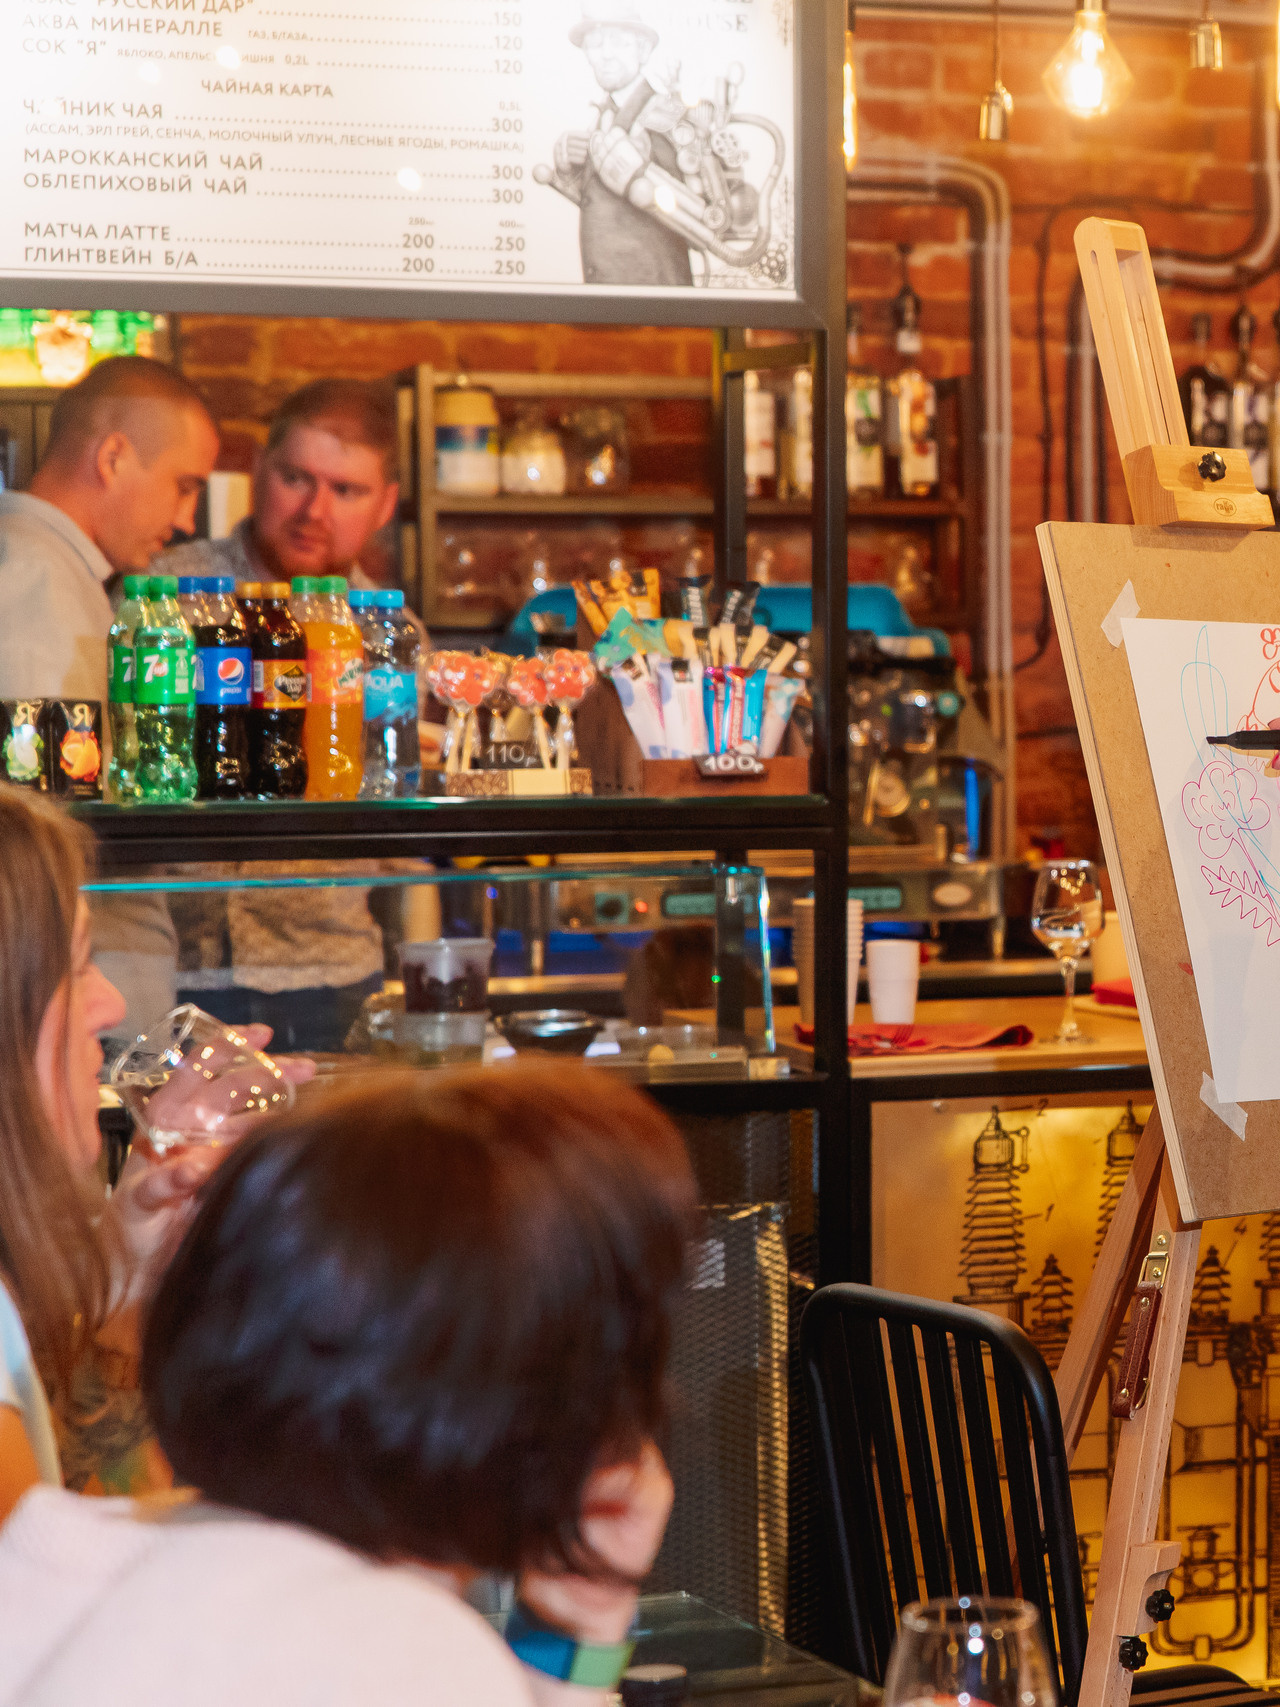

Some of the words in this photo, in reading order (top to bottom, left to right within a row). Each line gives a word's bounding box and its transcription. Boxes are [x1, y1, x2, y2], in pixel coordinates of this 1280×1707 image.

[22, 13, 79, 30] АКВА
[91, 16, 222, 37] МИНЕРАЛЛЕ
[493, 36, 522, 51] 120
[493, 12, 522, 27] 150
[22, 38, 66, 55] СОК
[77, 40, 106, 56] "Я"
[117, 49, 166, 60] ЯБЛОКО,
[234, 54, 275, 65] ИШНЯ
[285, 54, 309, 65] 0,2L
[493, 59, 522, 74] 120
[201, 78, 273, 95] ЧАЙНАЯ
[280, 83, 334, 98] КАРТА
[122, 102, 163, 119] ЧАЯ
[491, 118, 523, 133] 300
[25, 122, 83, 137] (АССАМ,
[87, 125, 112, 136] ЭРЛ
[116, 125, 154, 140] ГРЕЙ,
[156, 127, 205, 141] СЕНЧА,
[209, 130, 293, 144] МОЛОЧНЫЙ
[297, 133, 338, 147] УЛУН,
[340, 134, 394, 148] ЛЕСНЫЕ
[398, 137, 448, 151] ЯГОДЫ,
[451, 139, 525, 153] РОМАШКА)
[24, 148, 208, 169] МАРОККАНСКИЙ
[219, 152, 263, 170] ЧАЙ
[491, 165, 523, 180] 300
[23, 172, 192, 193] ОБЛЕПИХОВЫЙ
[204, 176, 248, 194] ЧАЙ
[491, 189, 523, 204] 300
[24, 221, 98, 239] МАТЧА
[105, 224, 171, 242] ЛАТТЕ
[402, 233, 434, 249] 200
[495, 236, 525, 252] 250
[24, 246, 152, 265] ГЛИНТВЕЙН
[164, 250, 198, 269] Б/А
[402, 257, 434, 273] 200
[495, 260, 525, 275] 250
